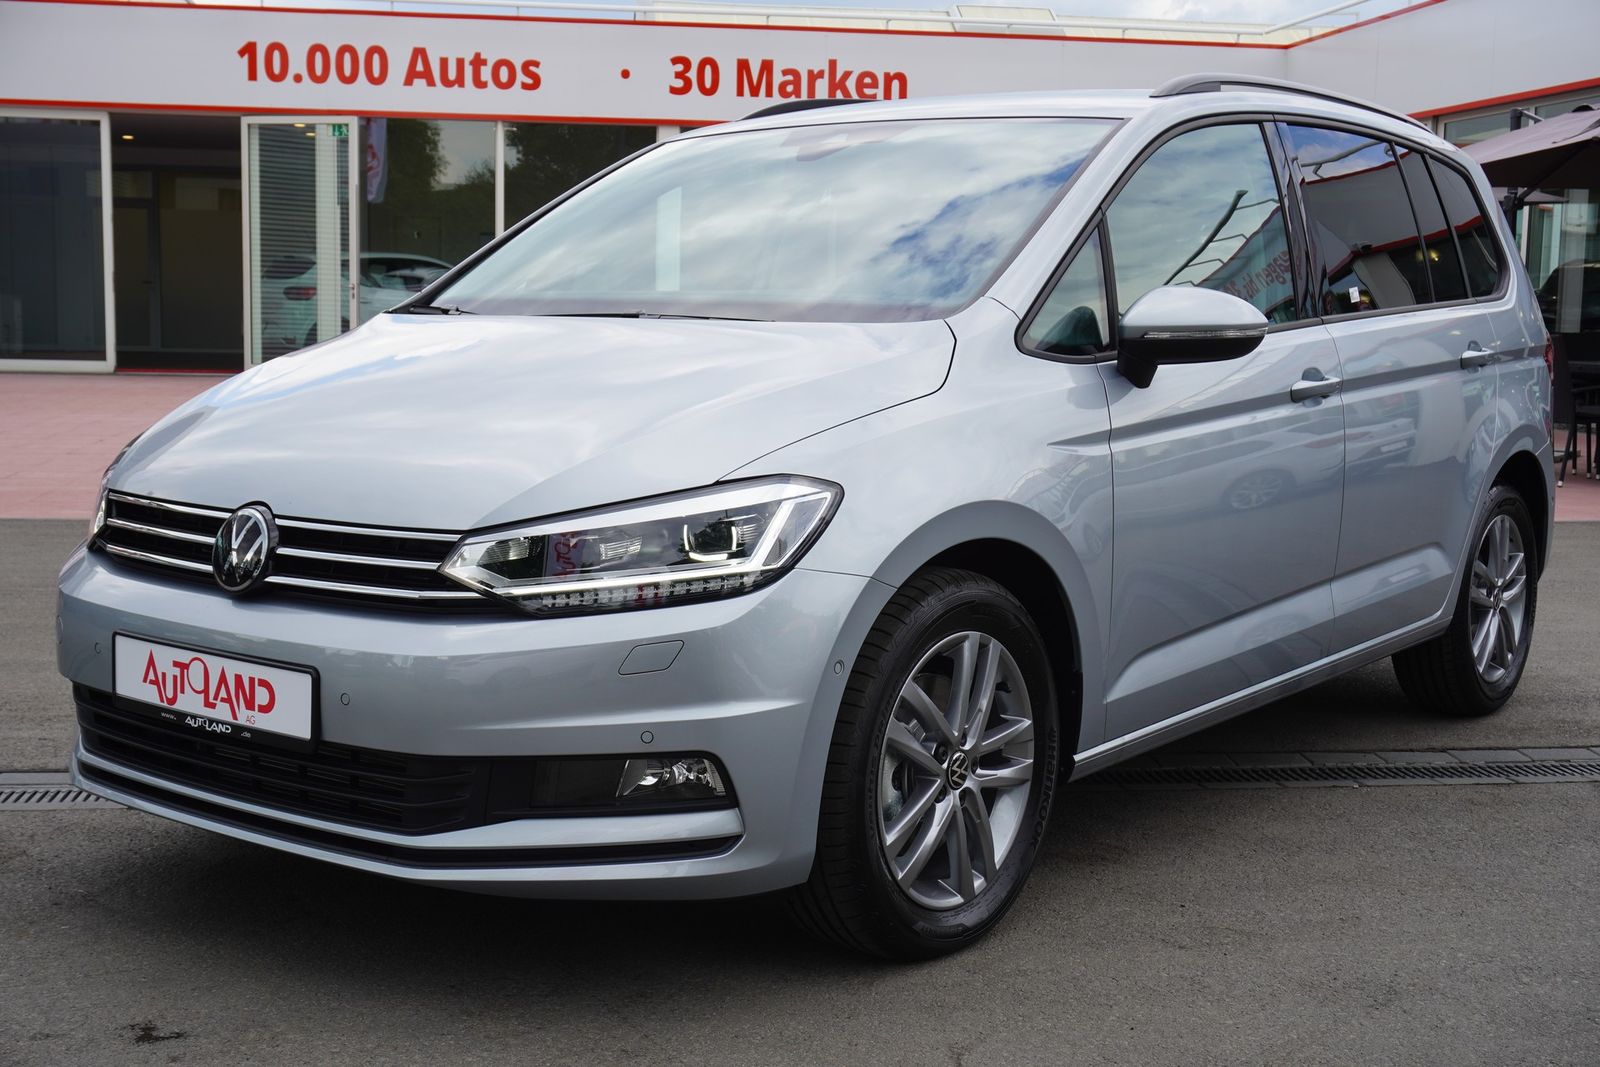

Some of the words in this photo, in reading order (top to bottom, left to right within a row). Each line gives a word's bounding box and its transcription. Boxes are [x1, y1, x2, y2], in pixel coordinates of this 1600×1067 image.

[237, 41, 389, 86] 10.000
[402, 47, 542, 91] Autos
[668, 55, 720, 97] 30
[736, 58, 908, 100] Marken
[142, 649, 276, 721] AUTOLAND
[185, 715, 232, 733] AUTOLAND
[245, 714, 256, 726] AG
